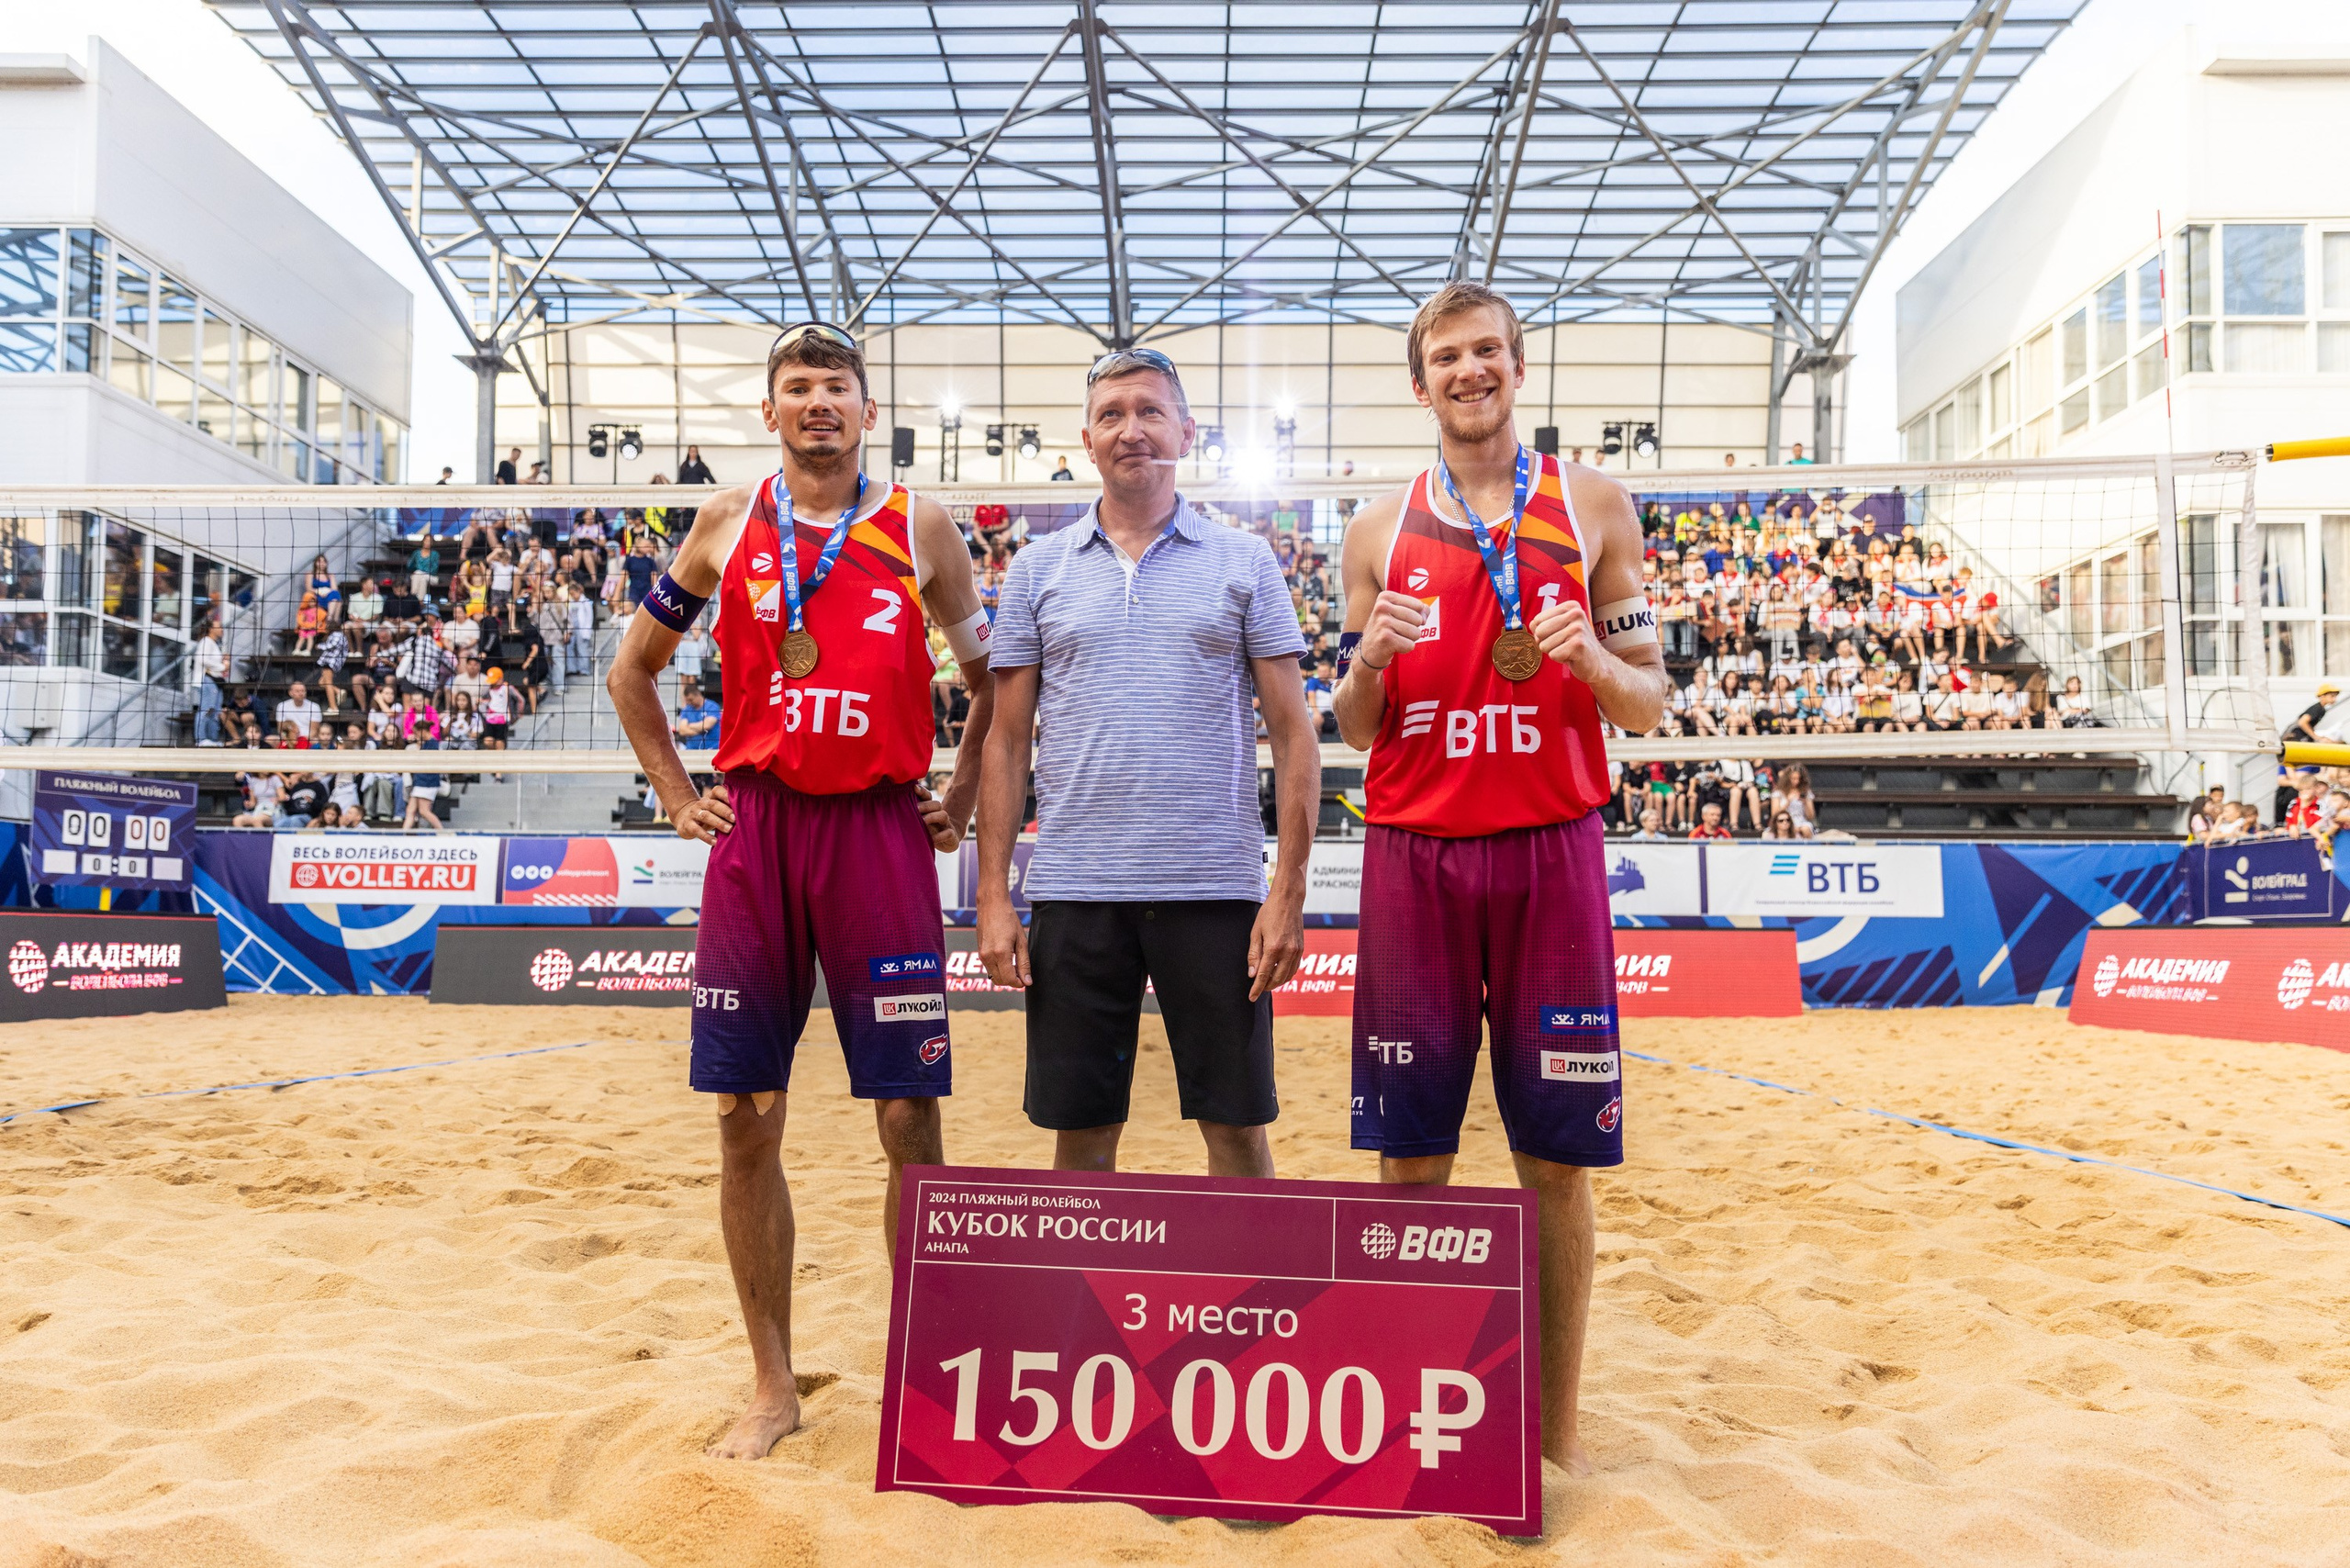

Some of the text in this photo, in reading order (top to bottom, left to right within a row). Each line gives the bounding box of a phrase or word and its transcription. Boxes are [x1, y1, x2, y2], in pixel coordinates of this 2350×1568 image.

[786, 571, 796, 591] ВФВ
[1505, 564, 1515, 585] ВФВ
[862, 588, 902, 634] 2
[1446, 704, 1541, 759] ВТБ
[293, 846, 477, 861] ВЕСЬ ВОЛЕЙБОЛ ЗДЕСЬ
[321, 864, 471, 889] VOLLEY.RU
[1807, 863, 1880, 893] ВТБ
[50, 941, 182, 971] АКАДЕМИЯ
[903, 958, 937, 971] ЯМАЛ
[2120, 958, 2231, 984] АКАДЕМИЯ
[695, 987, 740, 1011] ВТБ
[897, 999, 943, 1014] ЛУКОЙЛ
[929, 1192, 1102, 1210] 2024 ПЛЯЖНЫЙ ВОЛЕЙБОЛ
[927, 1210, 1167, 1244] КУБОК РОССИИ
[923, 1241, 970, 1254] АНАПА
[1397, 1224, 1494, 1264] ВФВ
[1122, 1294, 1300, 1338] 3 место
[938, 1347, 1136, 1450] 150
[1170, 1358, 1386, 1465] 000
